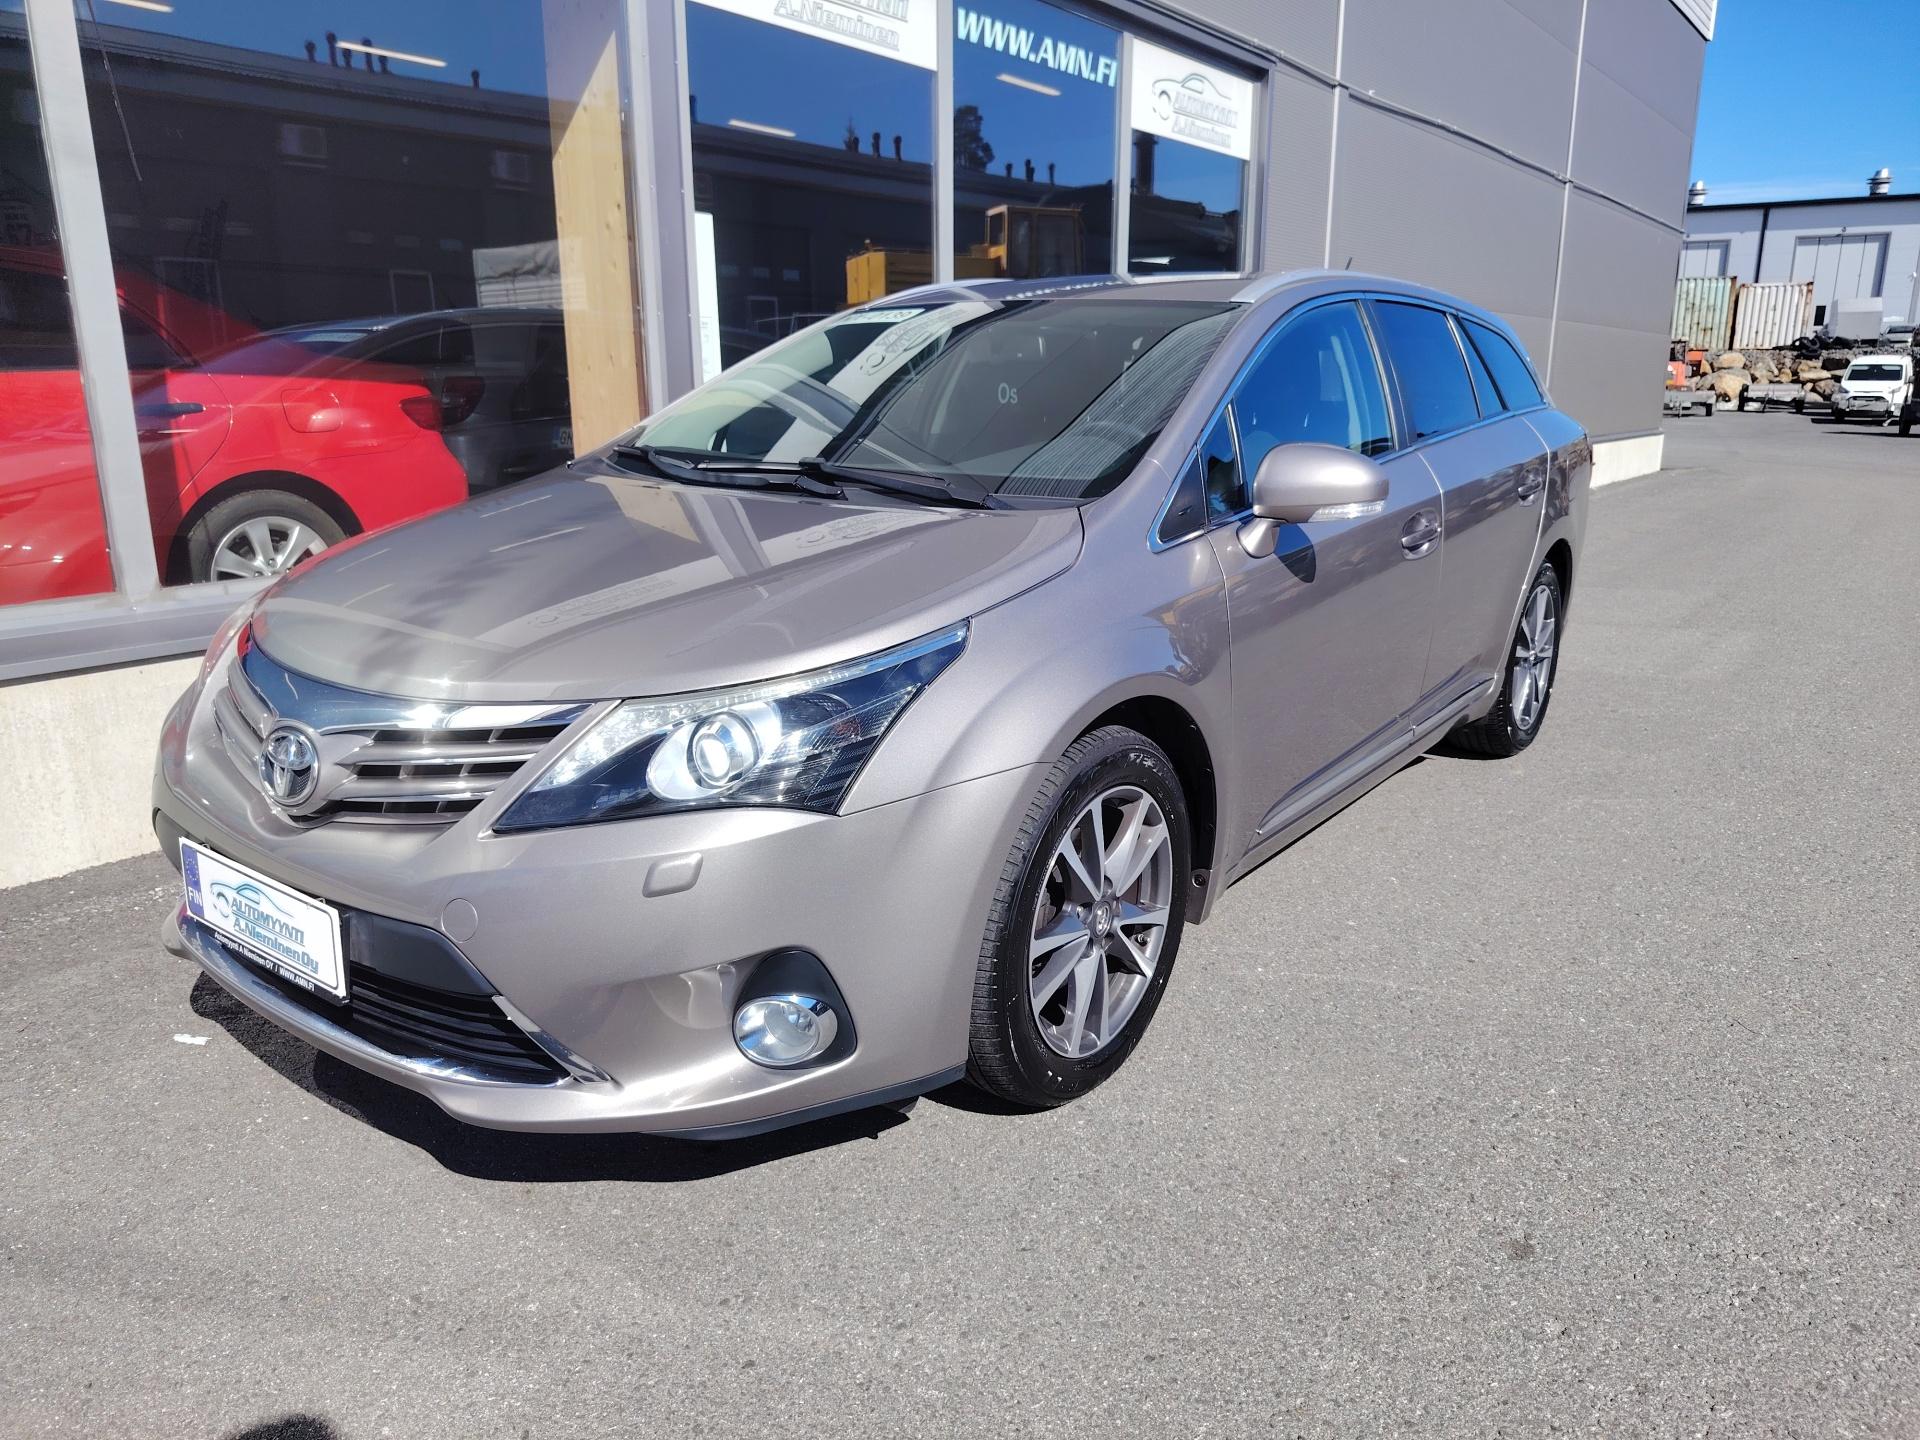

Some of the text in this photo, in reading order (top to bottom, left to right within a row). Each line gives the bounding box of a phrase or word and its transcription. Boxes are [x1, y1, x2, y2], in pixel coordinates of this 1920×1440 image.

[957, 7, 1118, 87] WWW.AMN.FI
[188, 886, 203, 907] FIN
[231, 896, 304, 944] AUTOMYYNTI
[266, 959, 273, 970] OY
